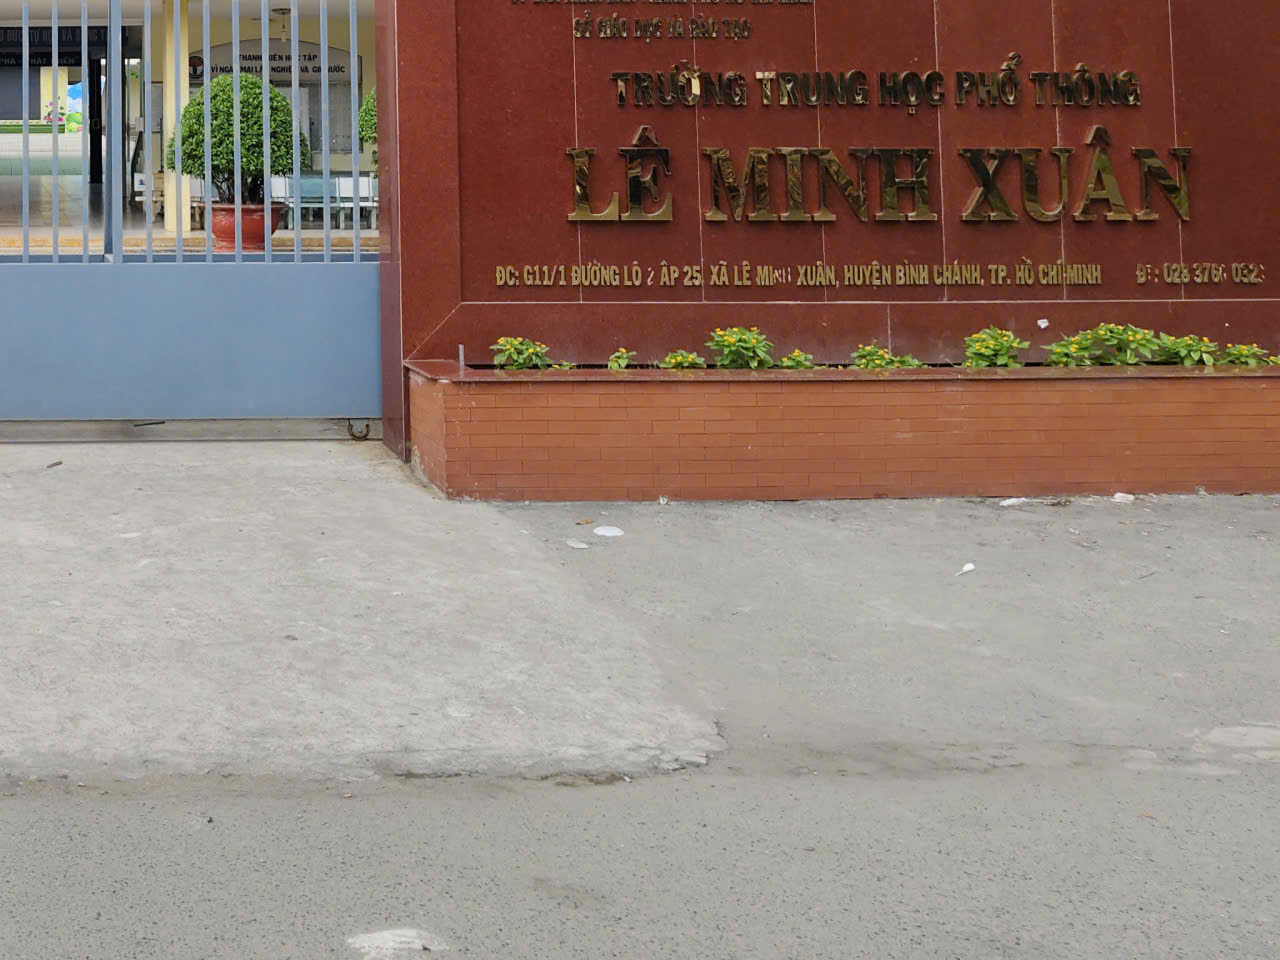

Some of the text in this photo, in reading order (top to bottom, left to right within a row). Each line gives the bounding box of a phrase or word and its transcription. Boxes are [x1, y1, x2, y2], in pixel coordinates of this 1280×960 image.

[573, 10, 752, 43] SỞ GIÁO DỤC VÀ ĐÀO TẠO
[240, 65, 254, 73] MAI
[301, 64, 310, 73] VÀ
[303, 53, 318, 63] TẬP
[610, 51, 1141, 114] TRƯỜNG TRUNG HỌC PHỔ THÔNG
[565, 125, 1193, 222] LÊ MINH XUÂN
[496, 264, 520, 286] ĐC:
[523, 264, 567, 286] G11/1
[571, 259, 620, 286] ĐƯỜNG
[623, 260, 642, 286] LÔ
[710, 260, 730, 286] XÃ
[734, 260, 752, 286] LÊ
[797, 260, 840, 288] XUÂN,
[843, 260, 892, 289] HUYỆN
[896, 259, 929, 285] BÌNH
[933, 259, 985, 286] CHÁNH,
[987, 264, 1011, 285] TP.
[1015, 256, 1035, 285] HỒ
[1039, 258, 1062, 285] CHÍ
[1066, 263, 1102, 285] MINH
[1163, 262, 1191, 283] 028
